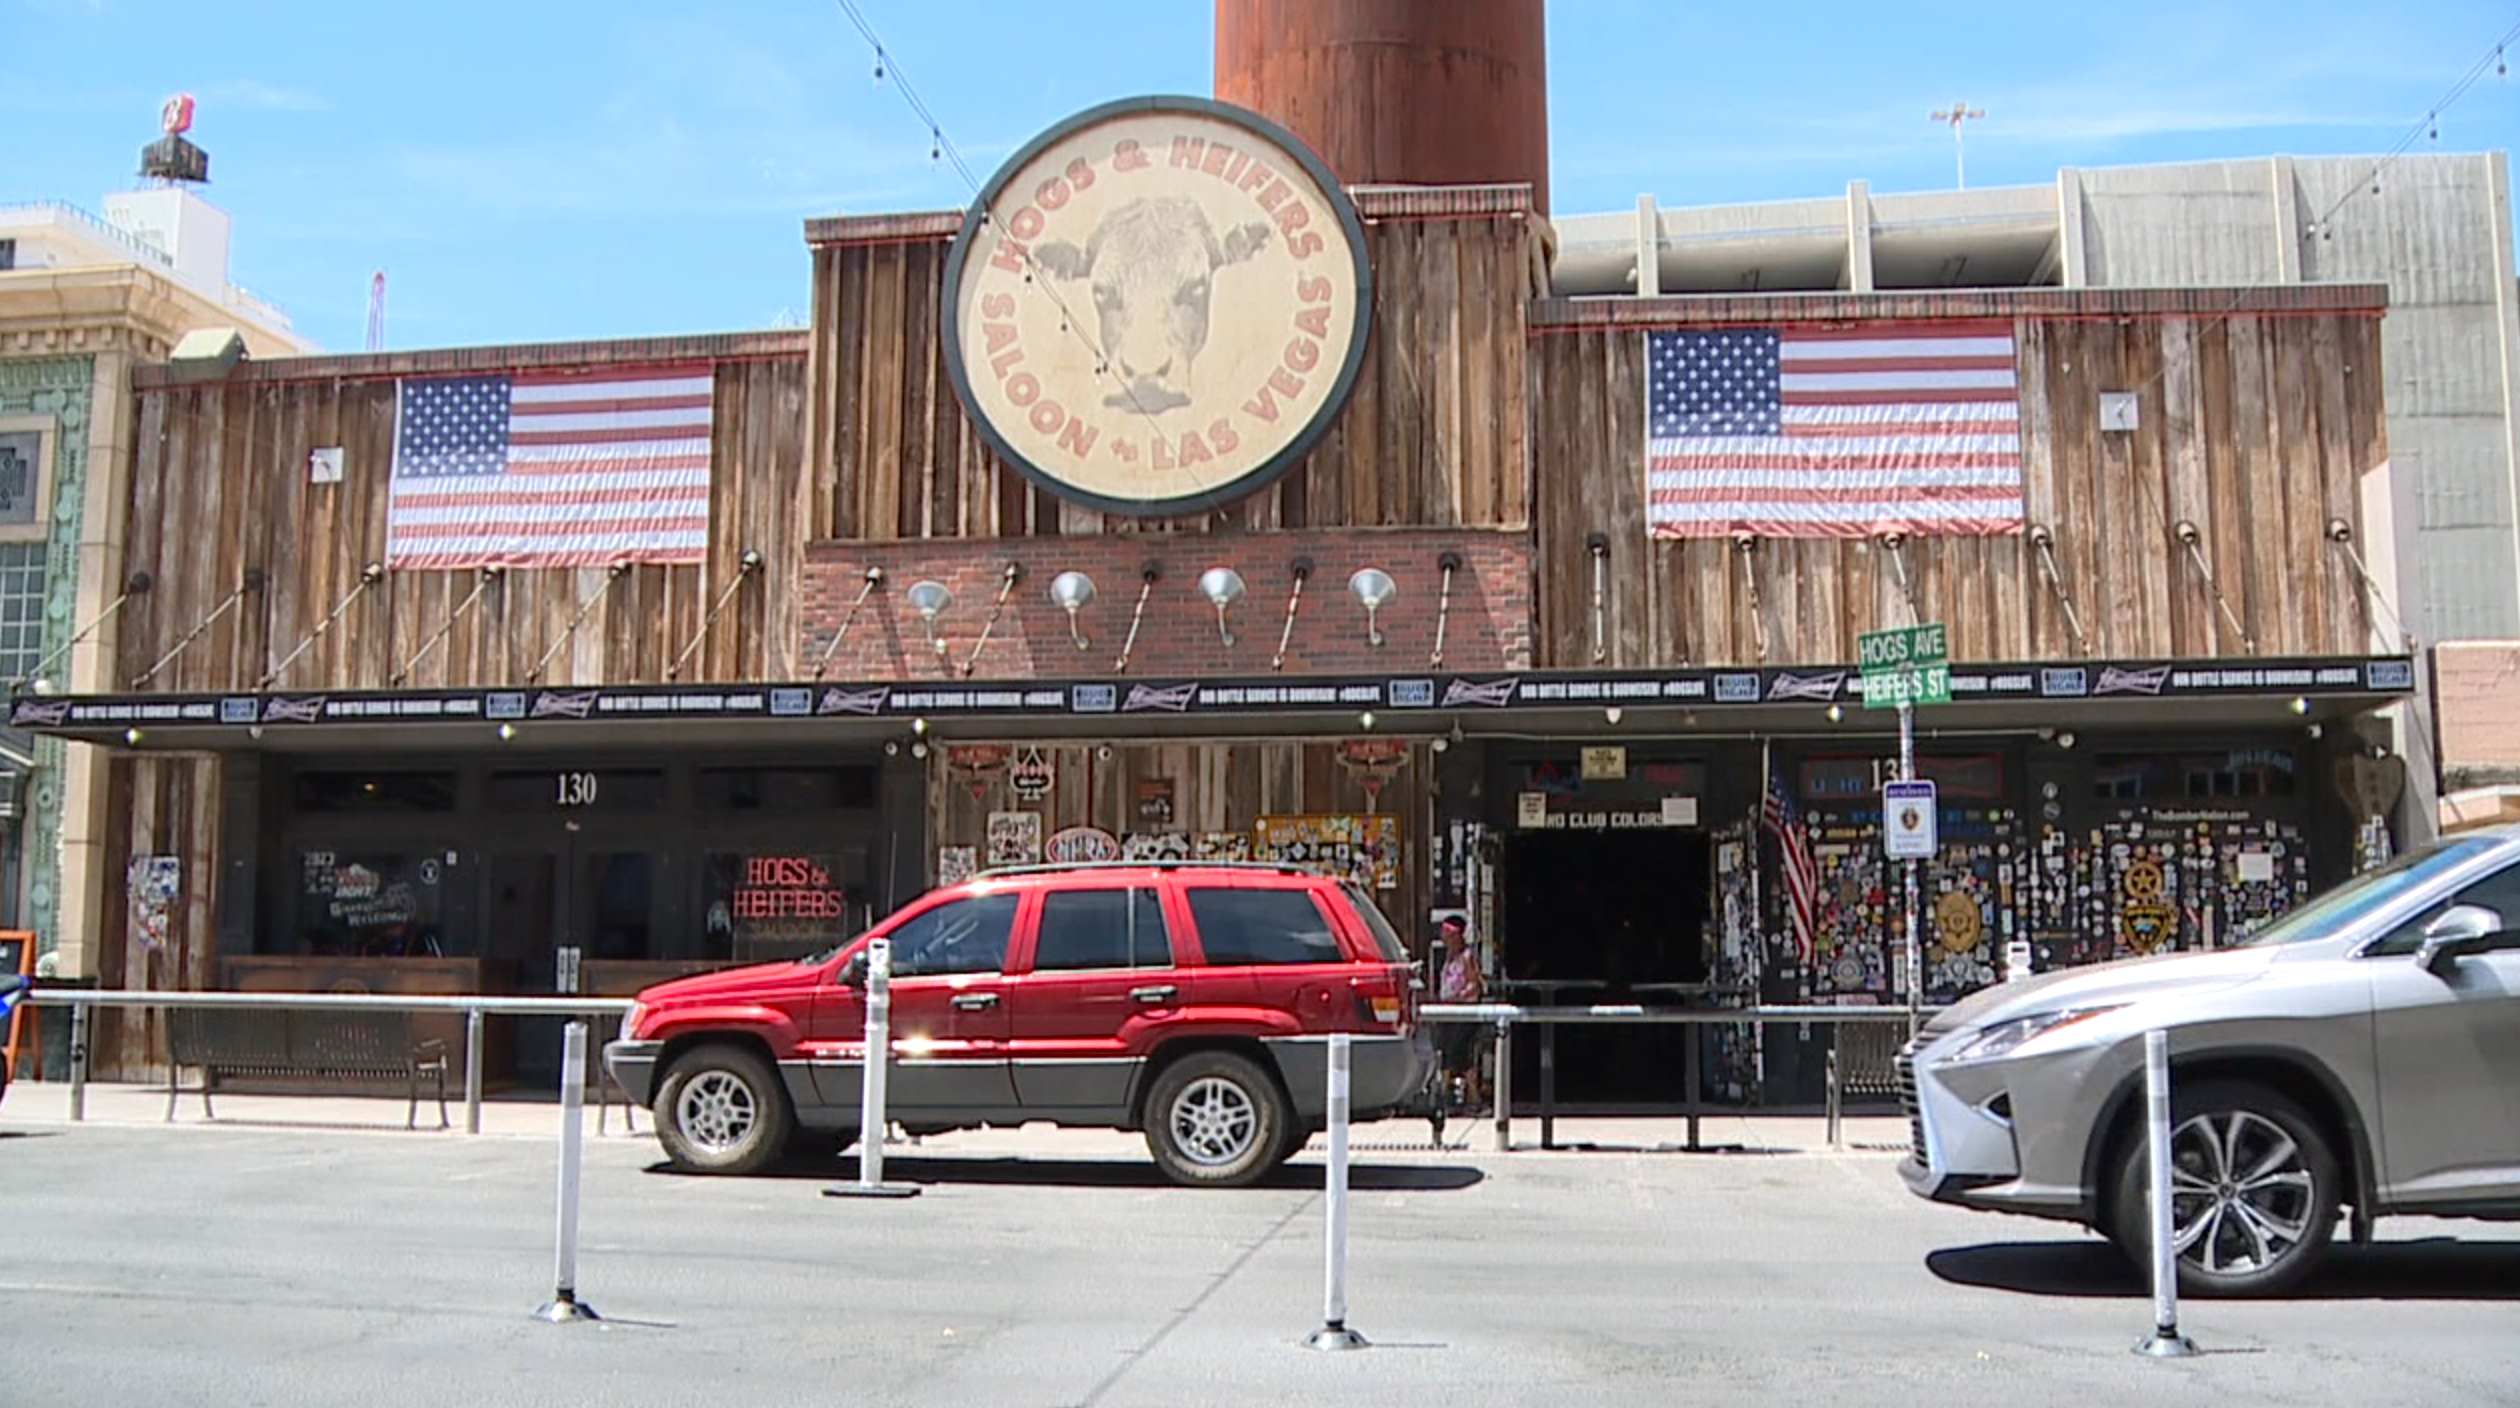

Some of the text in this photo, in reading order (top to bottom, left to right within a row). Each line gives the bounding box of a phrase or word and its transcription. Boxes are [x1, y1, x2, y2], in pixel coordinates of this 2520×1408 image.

[991, 136, 1325, 274] HOGS & HEIFERS
[982, 293, 1099, 458] SALOON
[1150, 418, 1239, 471] LAS
[1241, 275, 1333, 424] VEGAS
[1860, 628, 1944, 665] HOGS AVE
[1863, 670, 1923, 702] HEIFERS
[1928, 668, 1947, 698] ST
[557, 773, 597, 804] 130
[1870, 758, 1902, 791] 13
[1569, 812, 1606, 827] CLUB
[747, 858, 829, 885] HOGS &
[733, 890, 842, 917] HEIFERS
